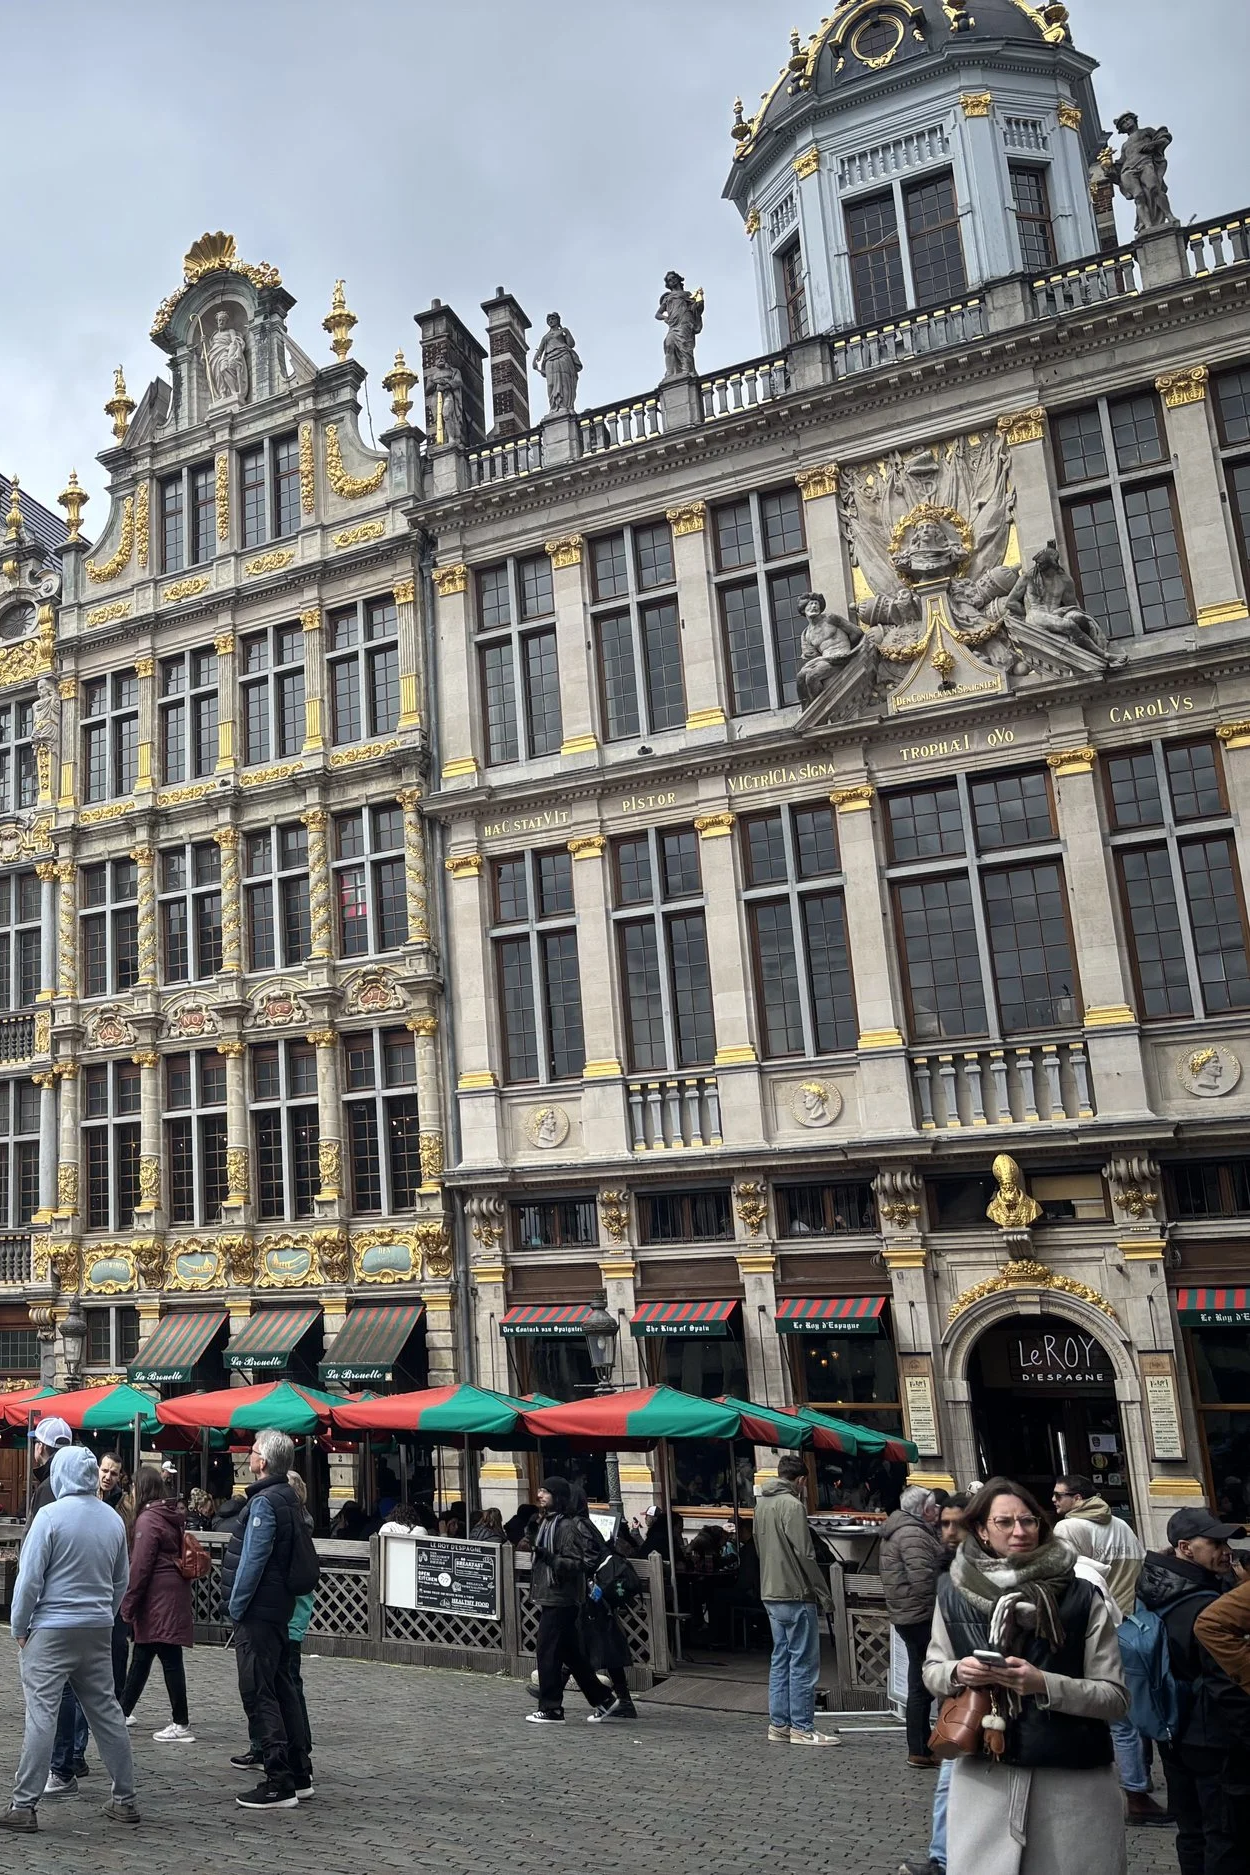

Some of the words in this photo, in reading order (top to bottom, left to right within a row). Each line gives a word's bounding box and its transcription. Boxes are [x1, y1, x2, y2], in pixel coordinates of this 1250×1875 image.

[622, 792, 677, 813] PISTOR
[645, 1324, 658, 1333] The
[229, 1356, 243, 1366] La
[133, 1371, 146, 1381] La
[325, 1369, 339, 1379] La
[1022, 1373, 1104, 1381] D'ESPAGNE
[451, 1545, 482, 1553] D'ESPAGNE
